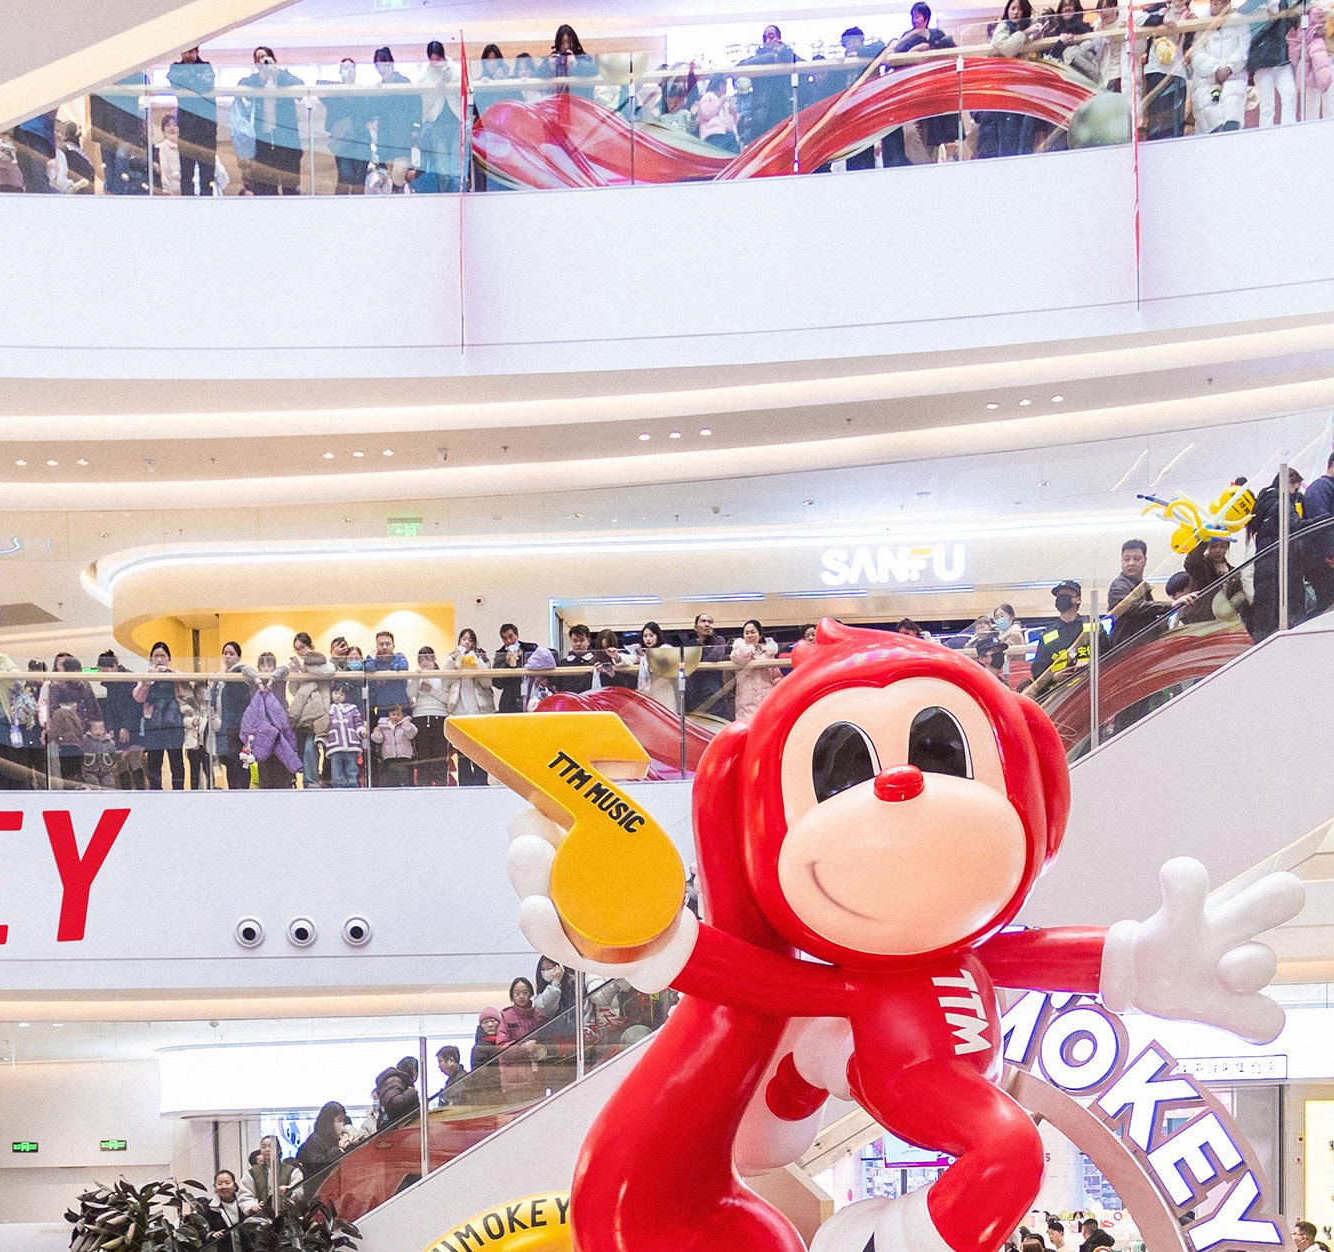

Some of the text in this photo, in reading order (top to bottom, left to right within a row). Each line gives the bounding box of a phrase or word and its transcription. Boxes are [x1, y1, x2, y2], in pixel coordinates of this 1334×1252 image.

[820, 543, 966, 586] SANFU
[547, 750, 646, 833] TTM MUSIC
[931, 969, 992, 1055] TTM
